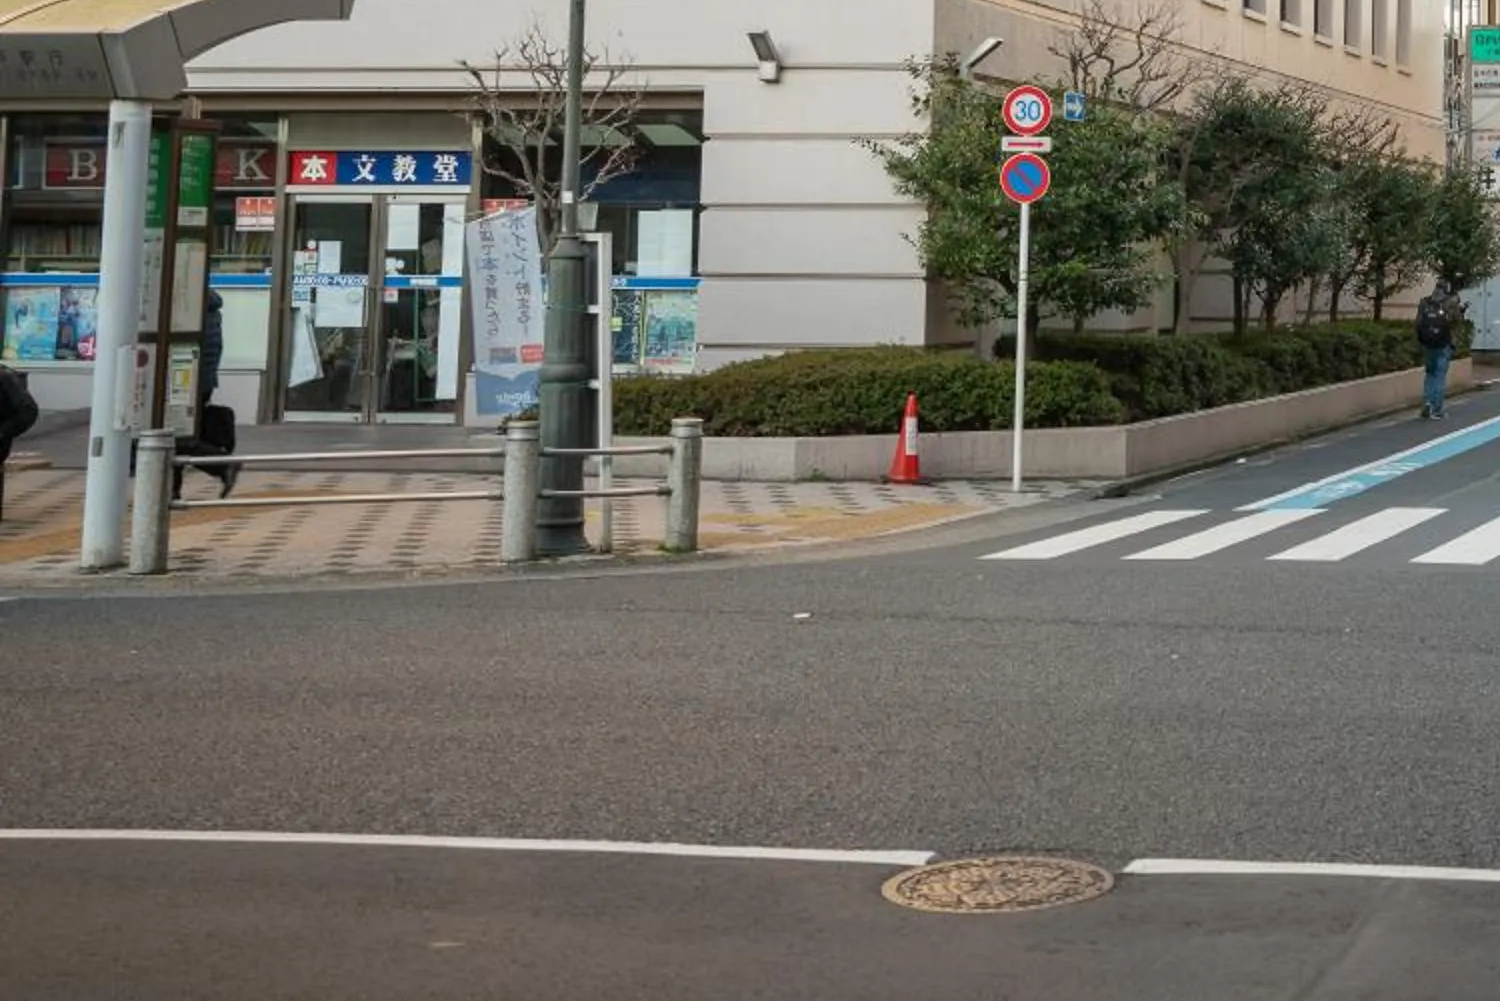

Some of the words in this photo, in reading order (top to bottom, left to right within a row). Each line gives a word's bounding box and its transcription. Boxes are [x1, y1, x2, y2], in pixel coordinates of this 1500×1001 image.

[1015, 100, 1041, 121] 30
[301, 155, 327, 181] 本
[352, 155, 459, 182] 文教堂
